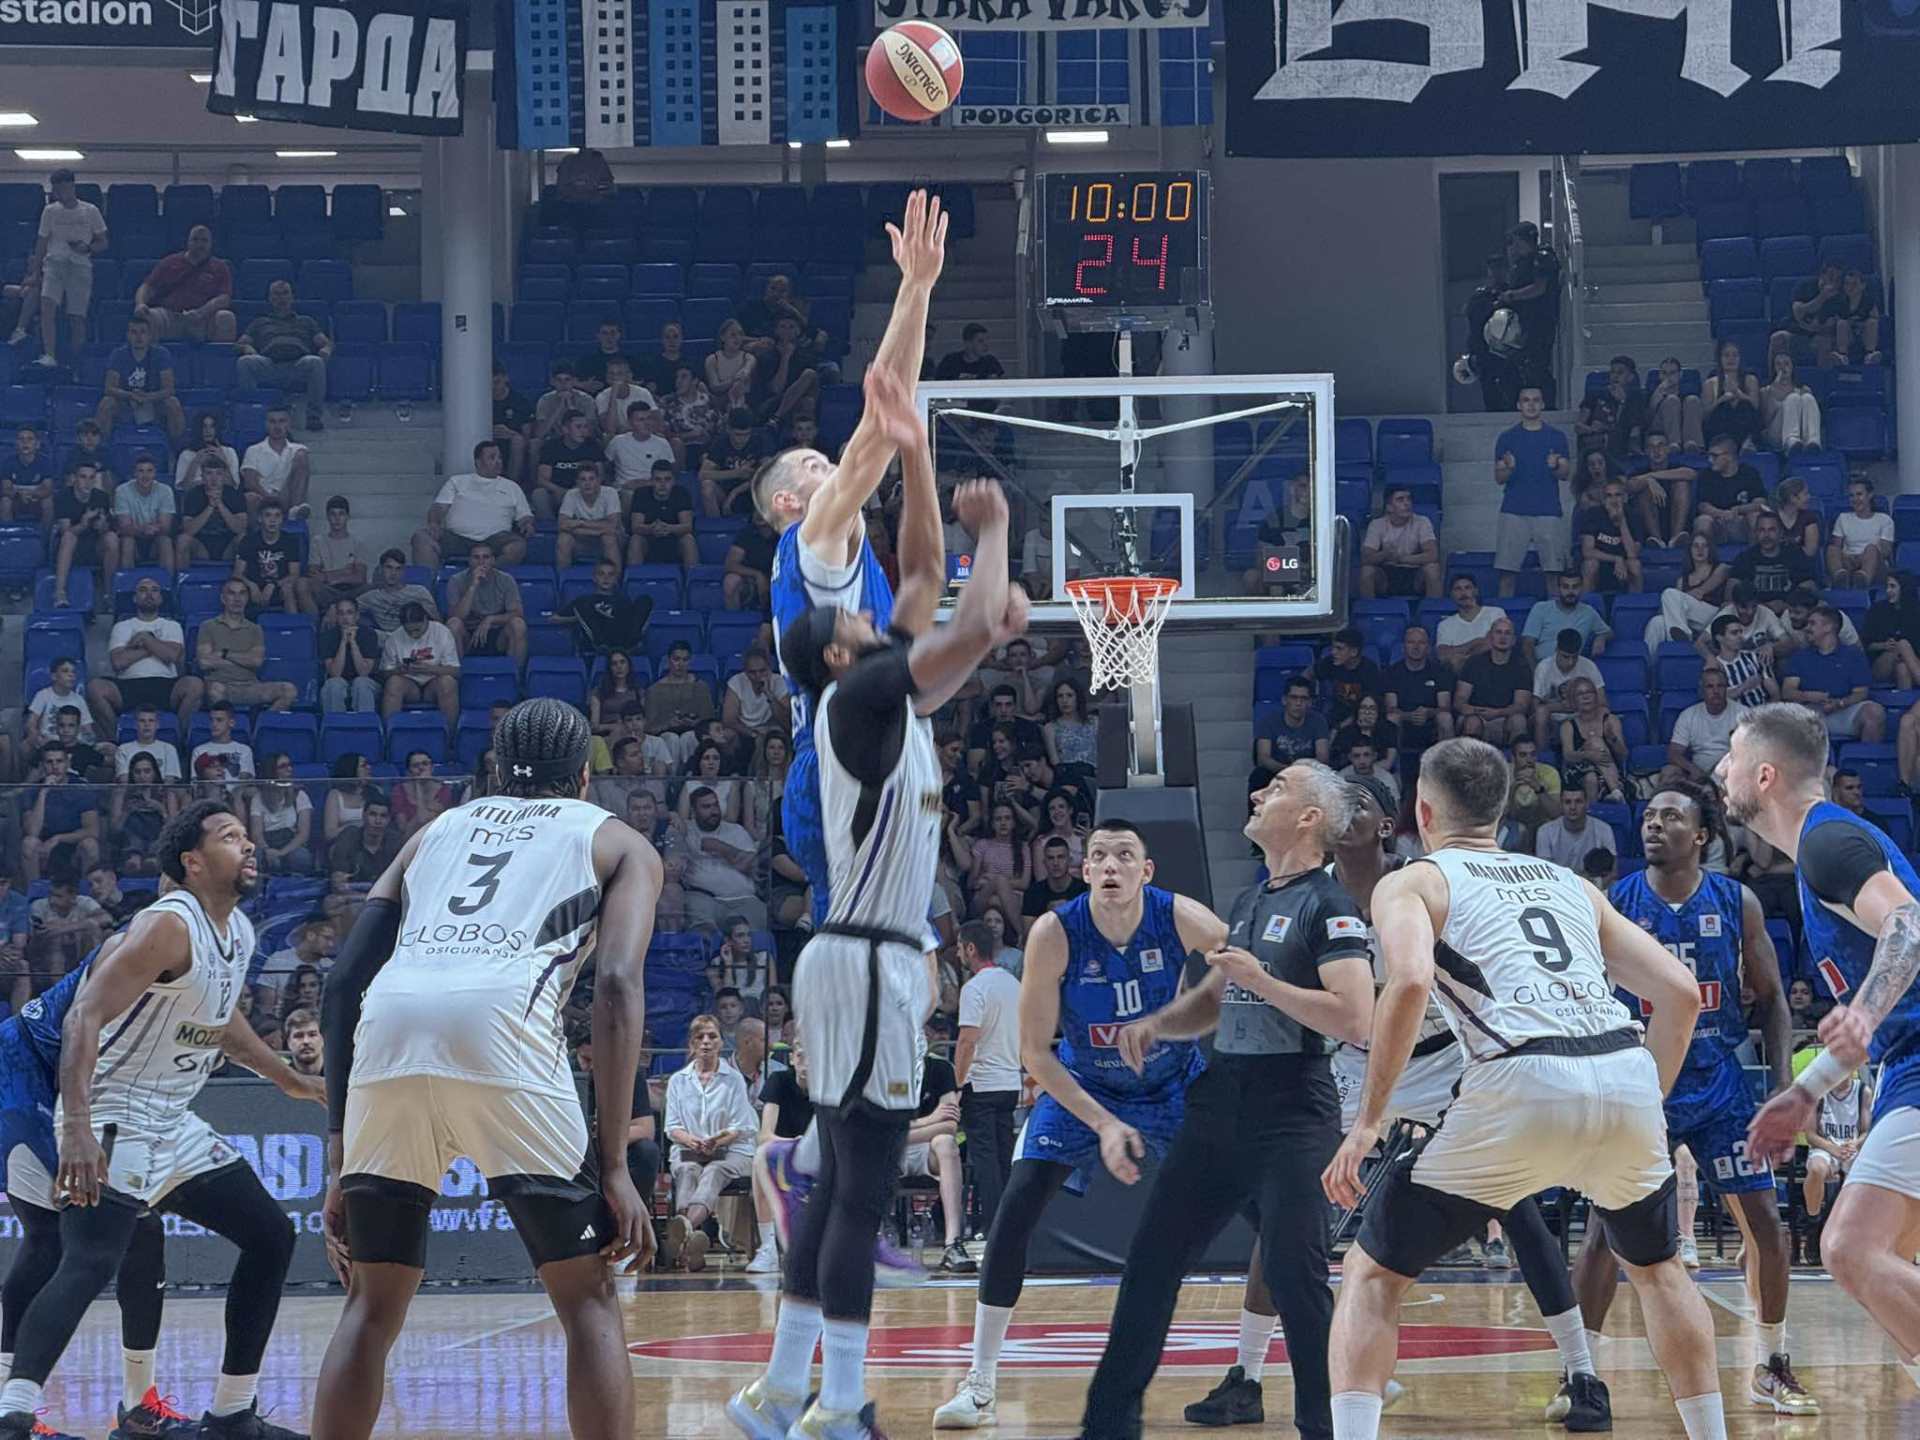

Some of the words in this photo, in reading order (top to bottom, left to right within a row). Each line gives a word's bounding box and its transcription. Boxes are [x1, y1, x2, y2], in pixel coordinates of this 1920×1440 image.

[0, 0, 152, 25] stadion
[214, 0, 460, 118] ГАРДА
[896, 43, 943, 102] SPALDING
[960, 107, 1121, 124] PODGORICA
[1070, 182, 1192, 222] 10:00
[1075, 234, 1168, 294] 24
[1282, 559, 1298, 569] LG
[470, 825, 536, 847] mts
[448, 851, 514, 916] 3
[1496, 886, 1551, 904] mts
[399, 923, 527, 951] GLOBOS
[1518, 907, 1573, 973] 9
[1113, 979, 1143, 1017] 10
